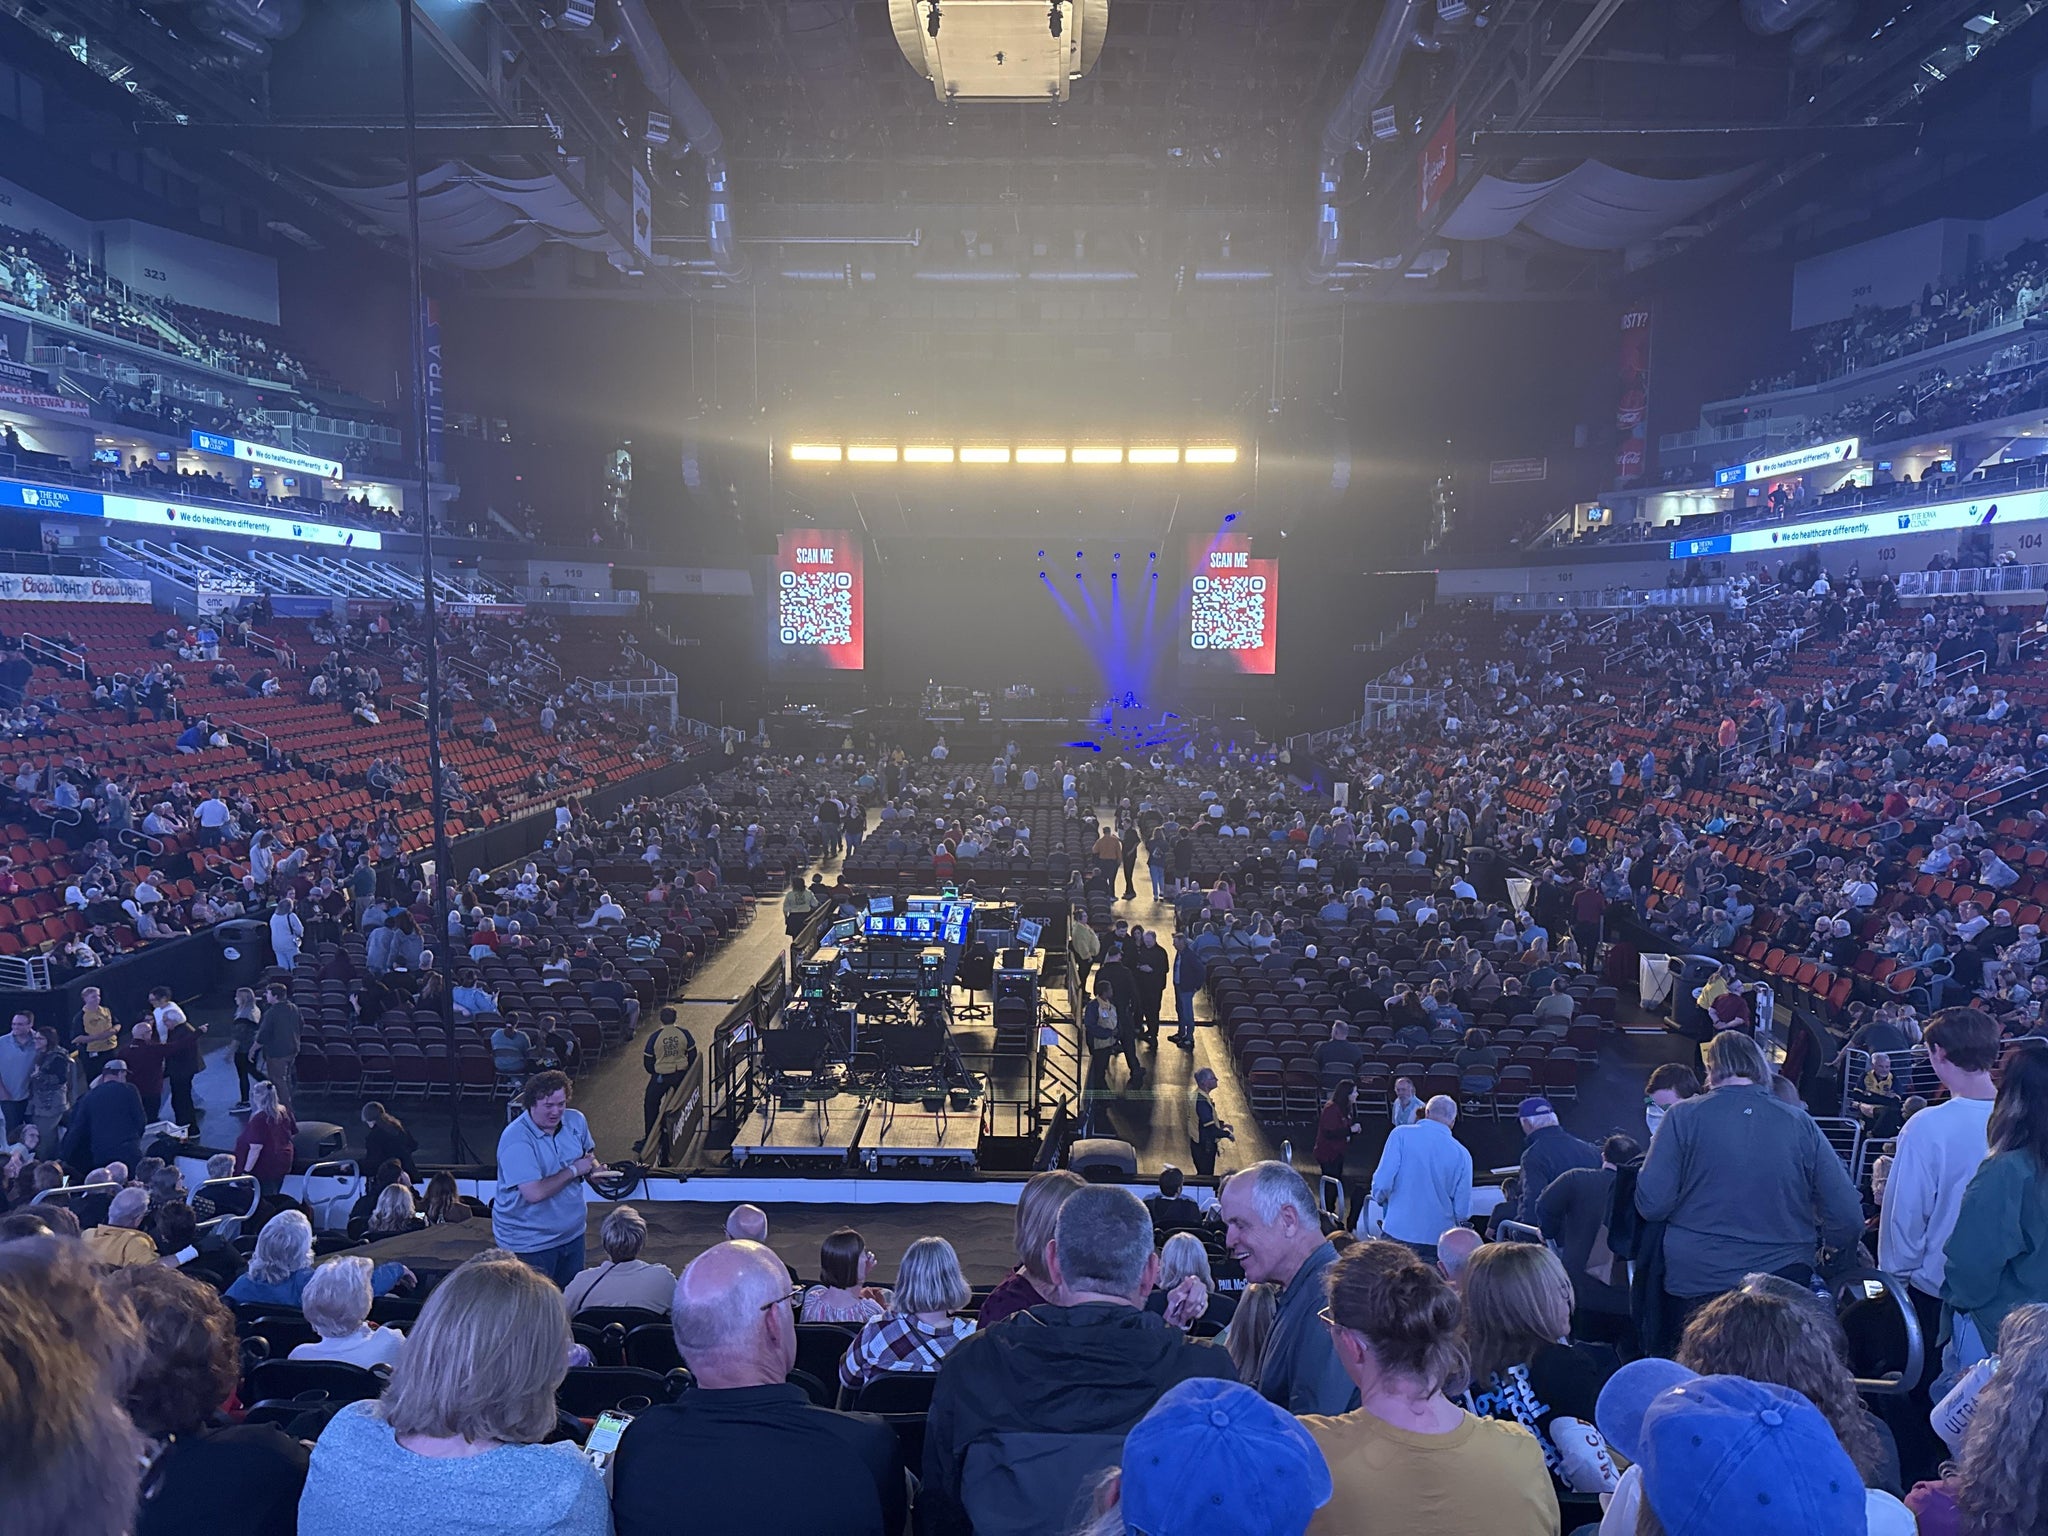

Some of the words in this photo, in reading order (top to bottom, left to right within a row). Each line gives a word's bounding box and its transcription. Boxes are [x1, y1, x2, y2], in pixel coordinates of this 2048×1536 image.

[143, 267, 167, 281] 323
[429, 344, 443, 433] ULTRA
[21, 396, 66, 408] FAREWAY
[1753, 407, 1773, 419] 201
[255, 450, 263, 458] We
[271, 453, 297, 465] healthcare
[1777, 458, 1802, 469] healthcare
[40, 490, 52, 499] THE
[52, 492, 70, 502] IOWA
[40, 499, 63, 508] CLINIC
[180, 512, 191, 521] We
[192, 514, 201, 522] do
[202, 514, 237, 527] healthcare
[238, 518, 271, 533] differently.
[1782, 533, 1790, 541] We
[1791, 531, 1799, 540] do
[1800, 527, 1832, 539] healthcare
[1832, 522, 1869, 535] differently.
[2018, 533, 2042, 549] 104
[796, 548, 818, 564] SCAN
[819, 548, 834, 564] ME
[1210, 552, 1233, 568] SCAN
[1234, 552, 1248, 568] ME
[1877, 547, 1896, 561] 103
[1557, 572, 1573, 582] 101
[22, 576, 54, 594] Coors
[55, 582, 82, 595] LIGHT
[91, 579, 120, 597] Coors
[120, 585, 144, 598] LIGHT
[207, 597, 222, 607] emc
[662, 1036, 679, 1044] CSC
[1218, 1279, 1233, 1291] PAUL
[1508, 1363, 1551, 1419] paul
